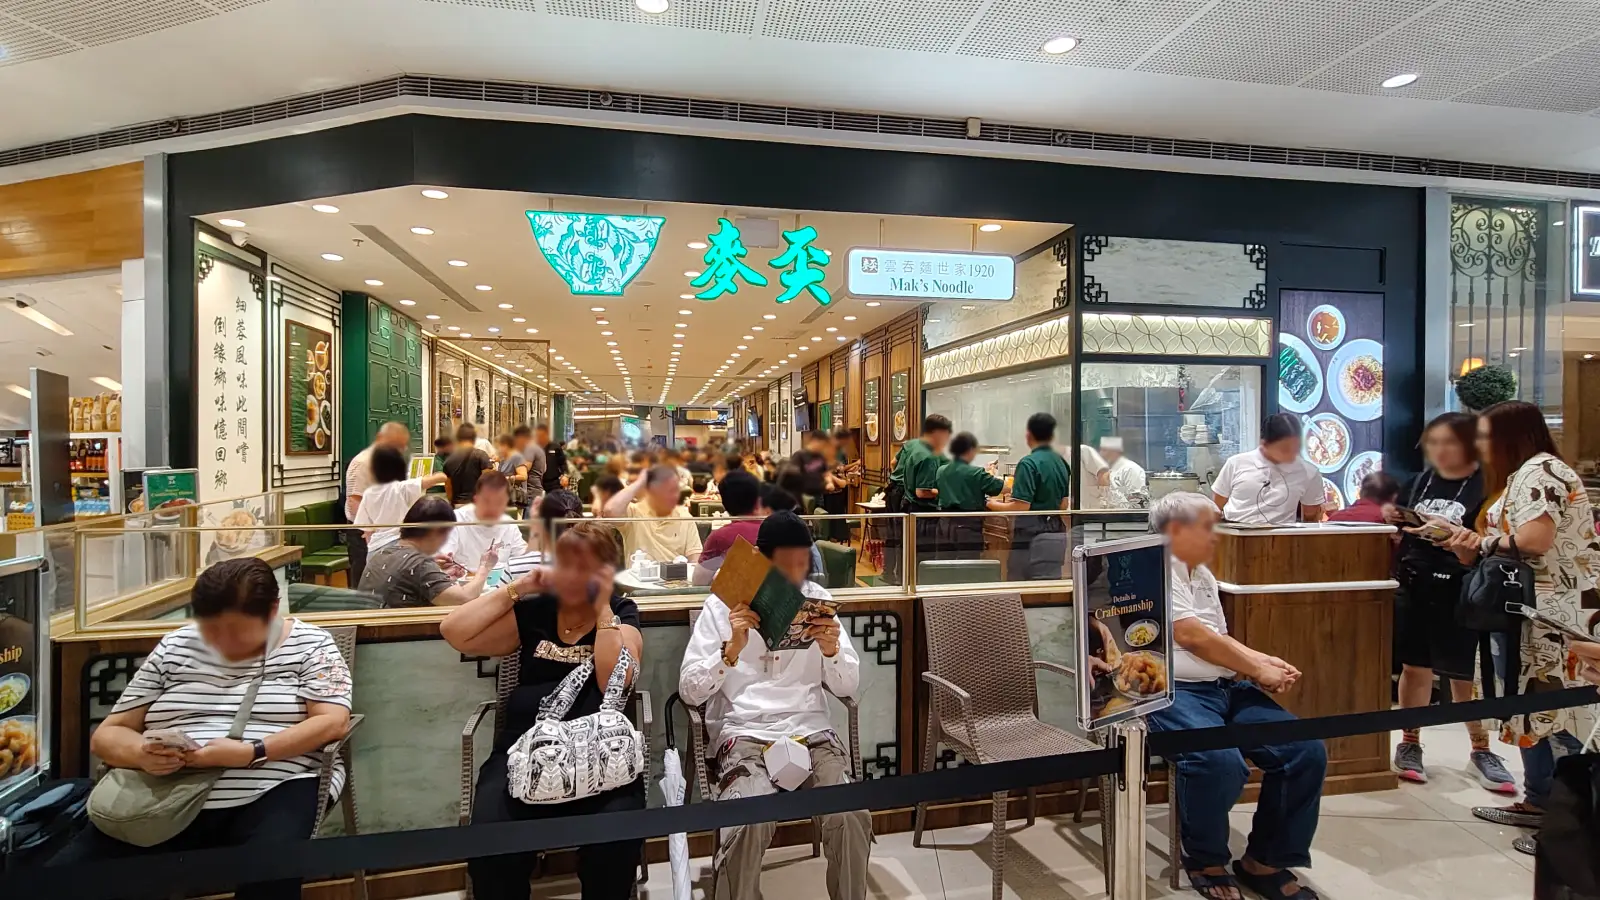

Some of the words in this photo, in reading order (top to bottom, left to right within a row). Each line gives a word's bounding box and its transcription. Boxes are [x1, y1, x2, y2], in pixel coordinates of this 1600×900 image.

[890, 277, 929, 293] Mak's
[932, 279, 974, 294] Noodle
[1113, 593, 1131, 604] Details
[1131, 592, 1137, 600] in
[1095, 599, 1154, 620] Craftsmanship
